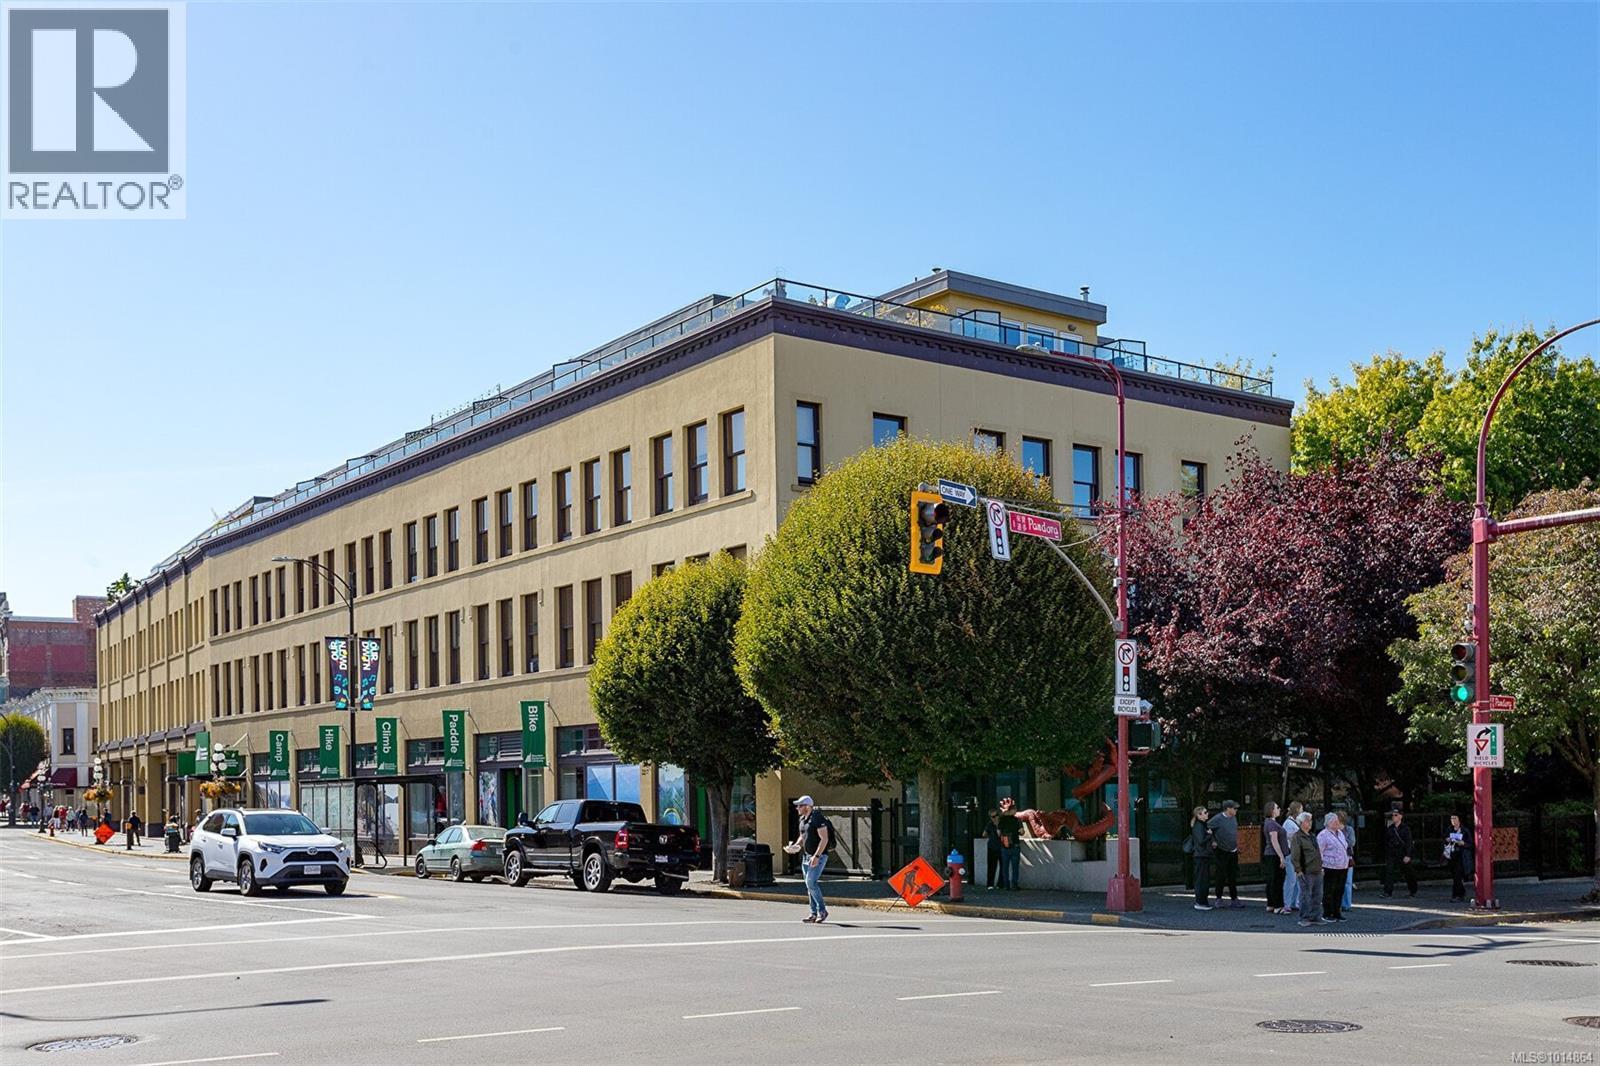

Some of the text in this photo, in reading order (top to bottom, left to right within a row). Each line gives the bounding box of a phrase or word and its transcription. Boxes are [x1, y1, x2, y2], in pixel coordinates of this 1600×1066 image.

[942, 486, 966, 498] ONE WAY
[1027, 517, 1059, 535] Pandora
[330, 641, 339, 661] OUR
[369, 641, 379, 661] OUR
[528, 705, 538, 732] Bike
[325, 728, 333, 751] Hike
[382, 721, 392, 754] Climb
[449, 714, 459, 754] Paddle
[274, 733, 285, 762] Camp
